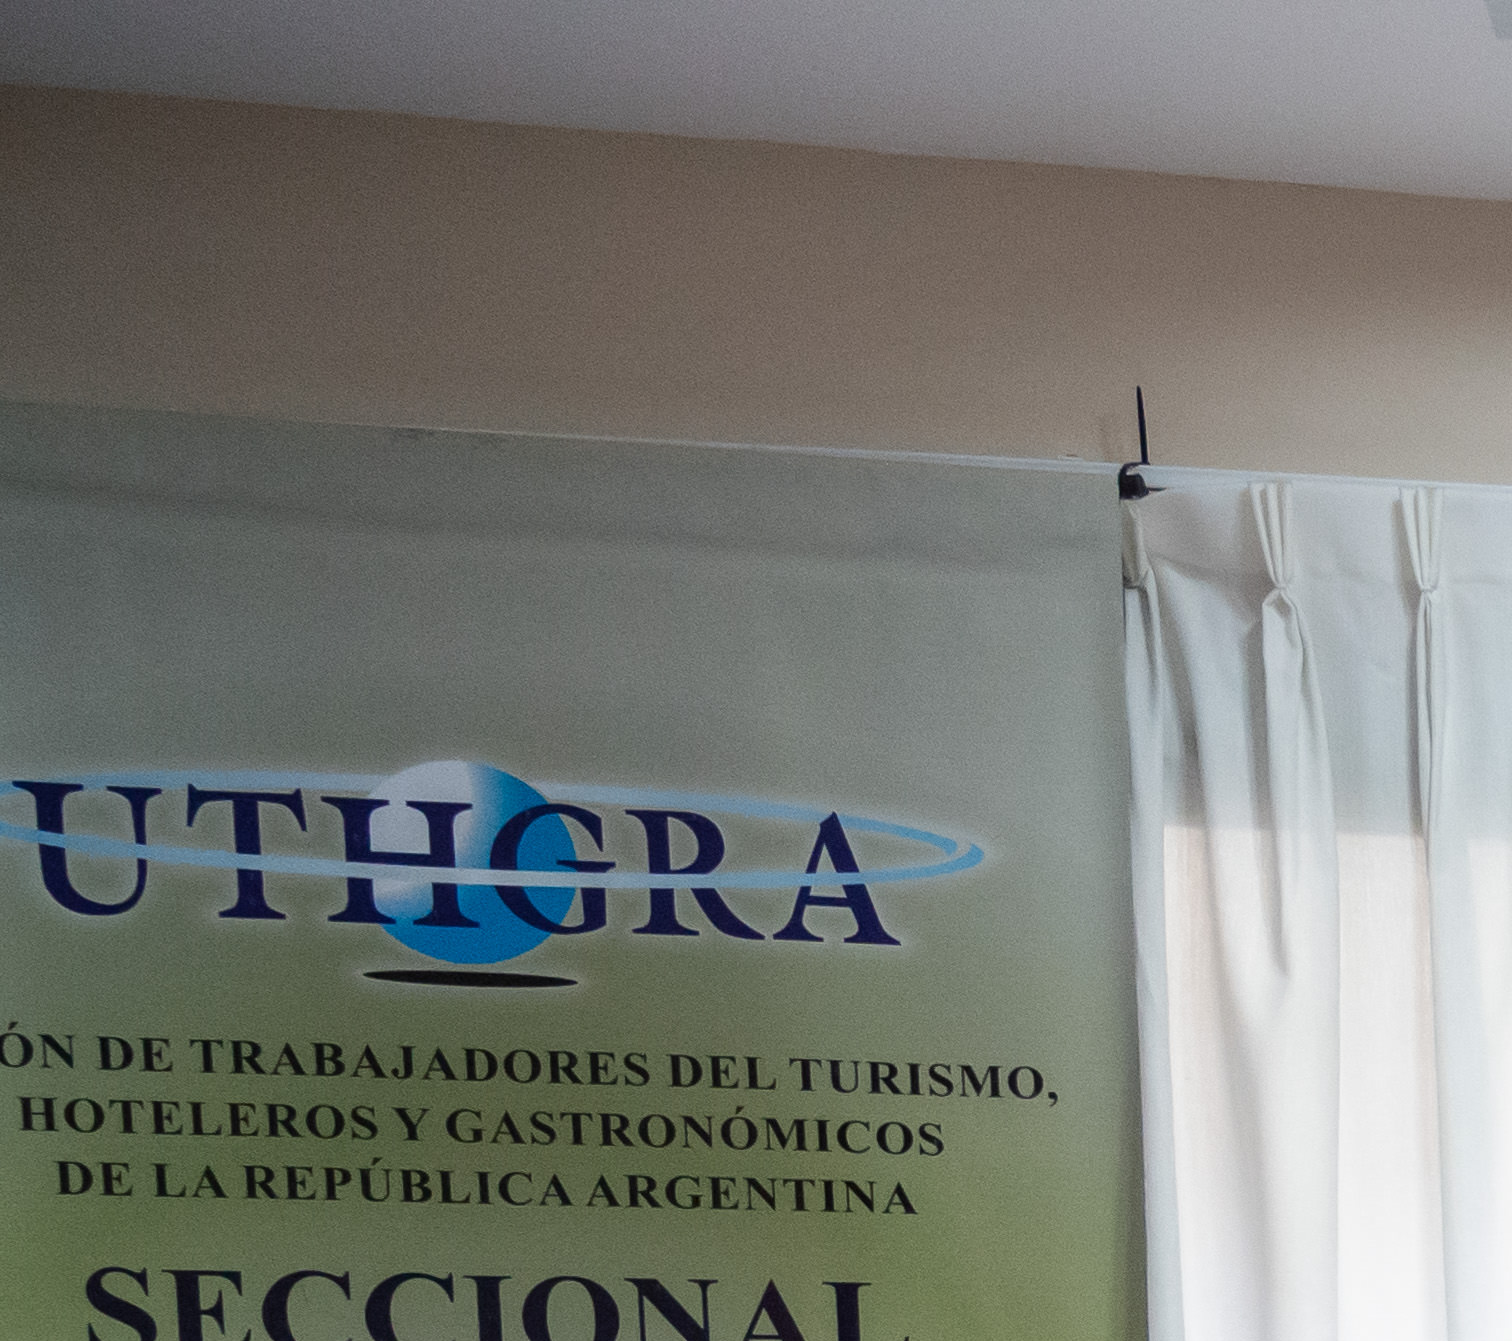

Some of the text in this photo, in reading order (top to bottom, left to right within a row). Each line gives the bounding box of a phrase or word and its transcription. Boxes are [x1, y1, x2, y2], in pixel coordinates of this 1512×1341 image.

[11, 780, 902, 946] UTHGRA
[97, 1035, 174, 1072] DE
[189, 1039, 650, 1087] TRABAJADORES
[666, 1053, 778, 1091] DEL
[789, 1057, 1060, 1106] TURISMO,
[18, 1096, 945, 1157] HOTELEROS Y GASTRONÓMICOS
[56, 1156, 918, 1215] DE LA REPÚBLICA ARGENTINA
